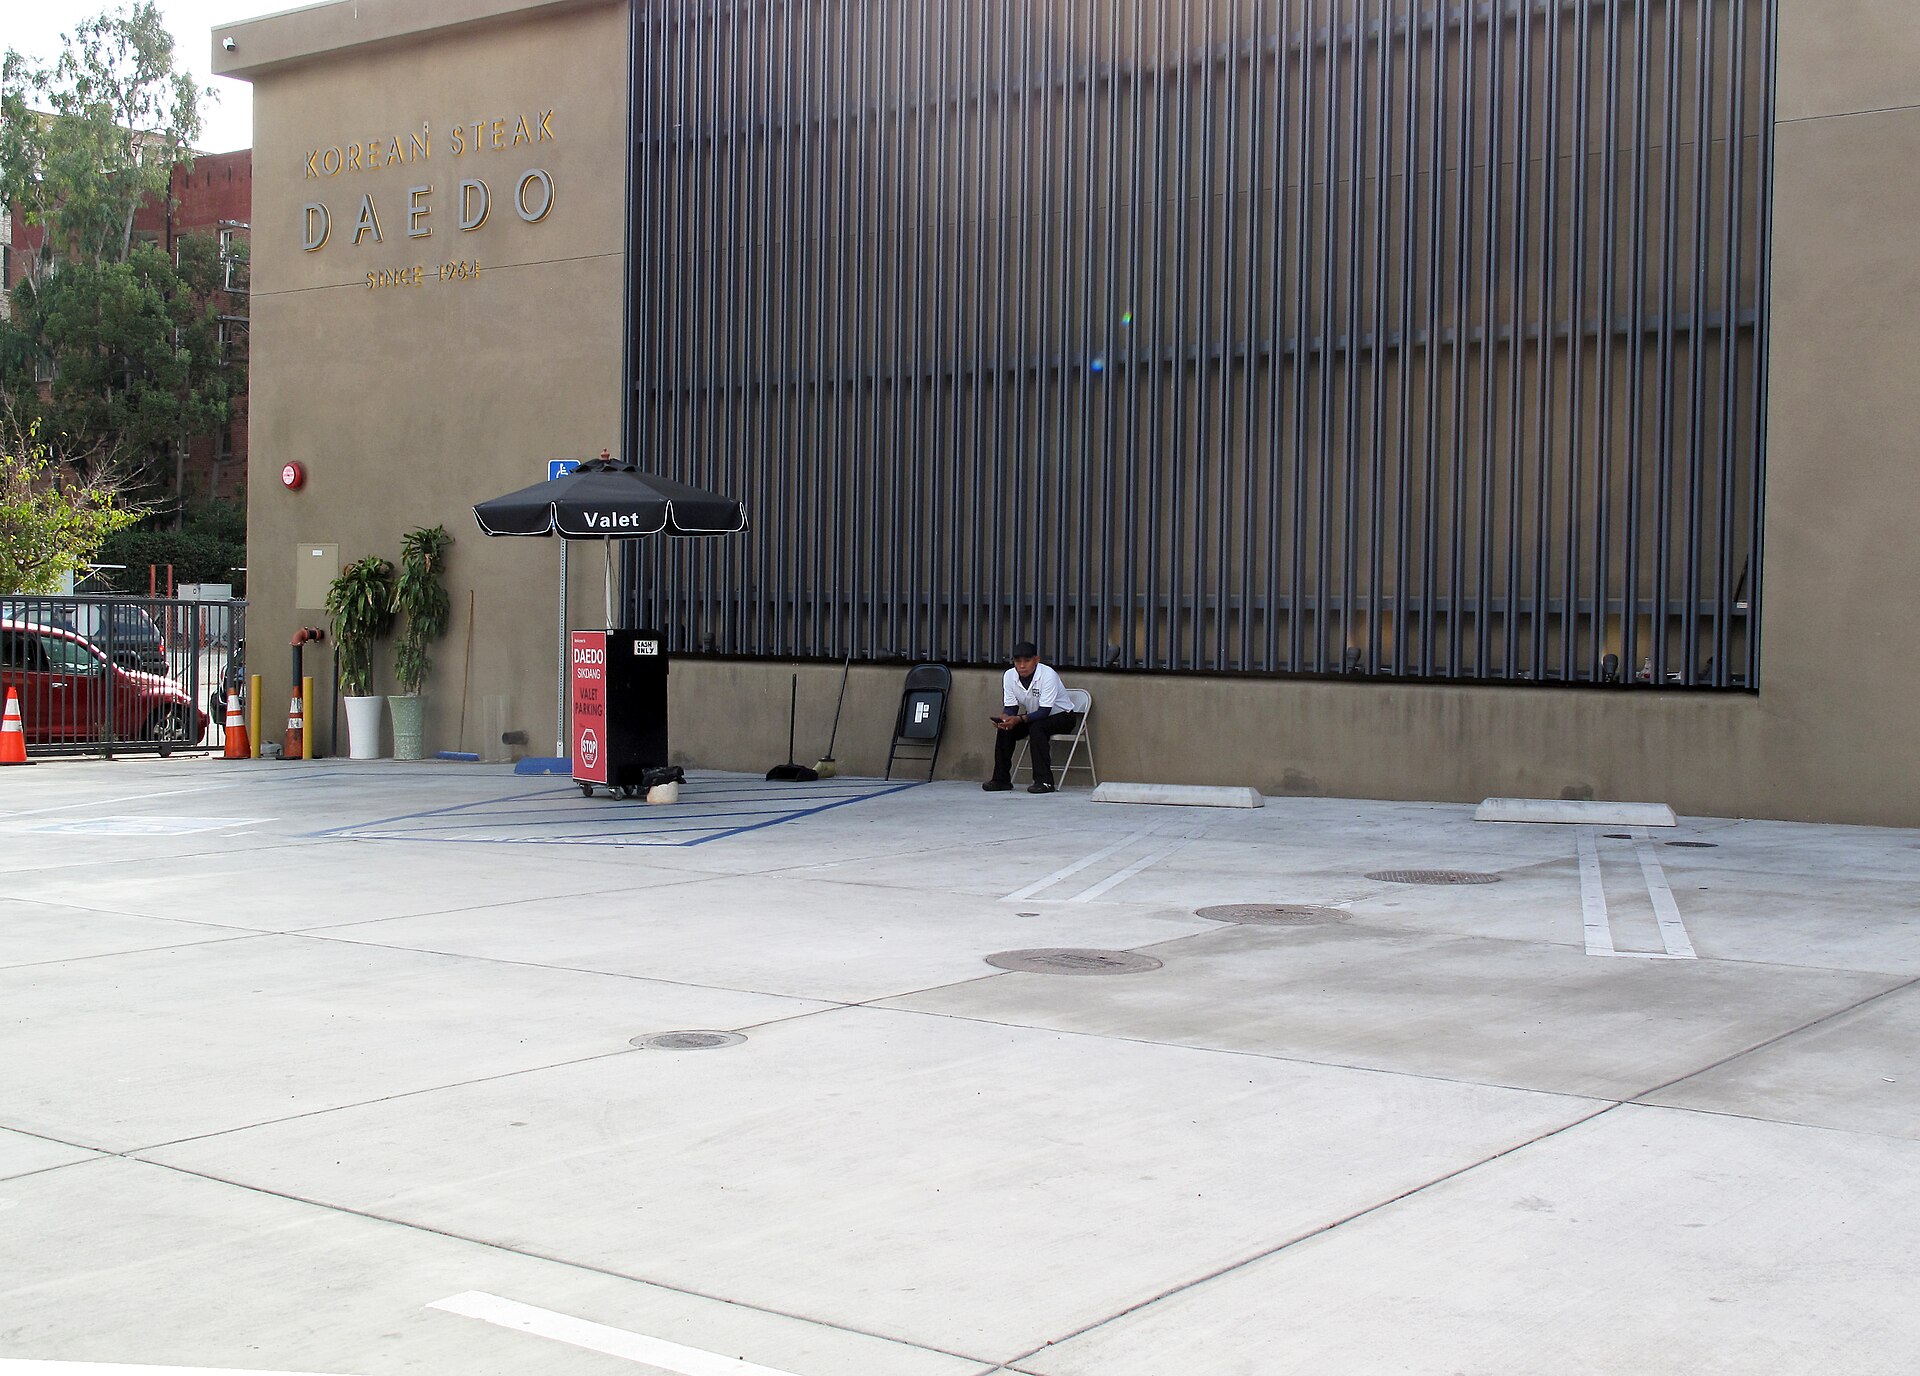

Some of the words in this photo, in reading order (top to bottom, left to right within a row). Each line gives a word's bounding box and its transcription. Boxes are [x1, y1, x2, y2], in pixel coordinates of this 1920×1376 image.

[304, 131, 430, 180] KOREAN
[450, 108, 555, 156] STEAK
[303, 168, 555, 252] DAEDO
[365, 265, 424, 289] SINCE
[438, 258, 481, 283] 1964
[583, 511, 640, 528] Valet
[574, 649, 603, 664] DAEDO
[577, 668, 601, 680] SIKDANG
[580, 688, 598, 700] VALET
[575, 703, 603, 717] PARKING
[582, 740, 596, 753] STOP
